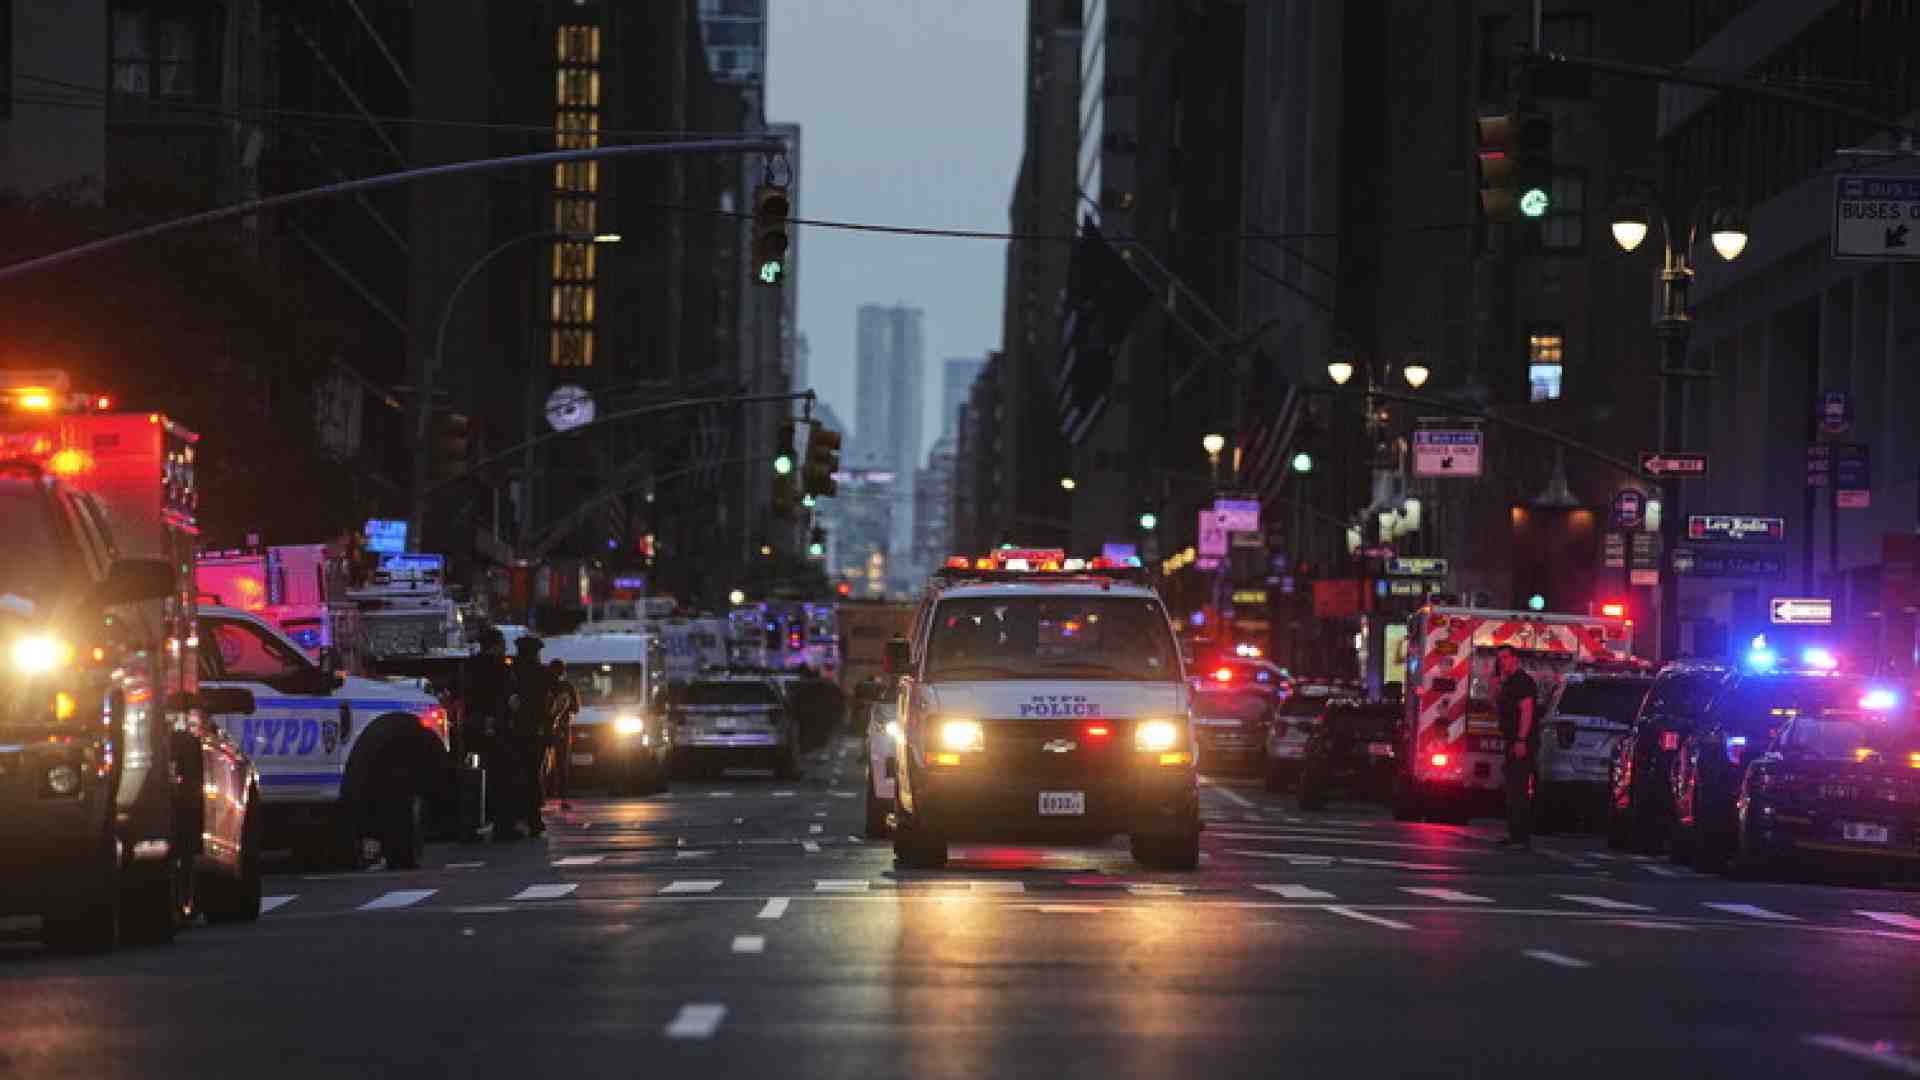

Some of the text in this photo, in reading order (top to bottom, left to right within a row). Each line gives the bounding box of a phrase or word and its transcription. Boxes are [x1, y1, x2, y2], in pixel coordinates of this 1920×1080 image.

[1842, 202, 1902, 220] BUSES
[1018, 703, 1101, 716] POLICE
[241, 718, 320, 756] NYPD
